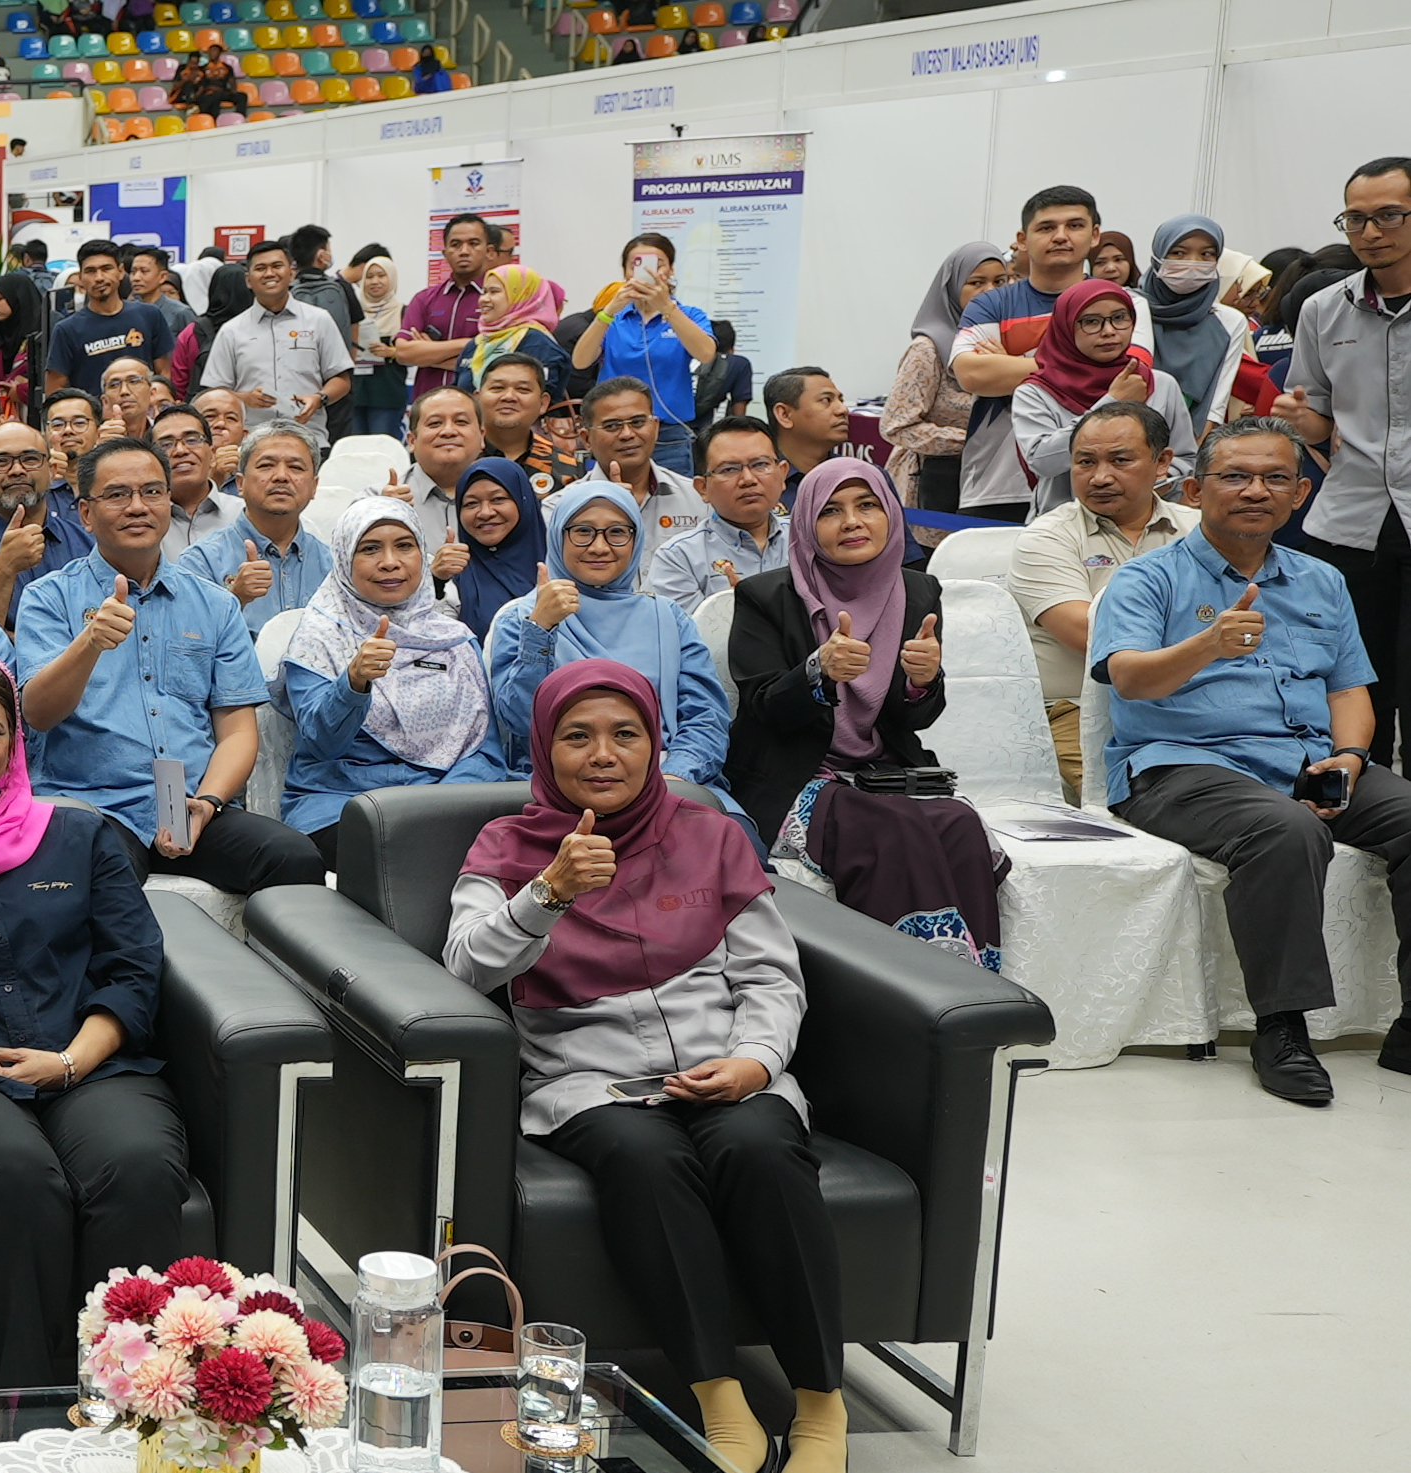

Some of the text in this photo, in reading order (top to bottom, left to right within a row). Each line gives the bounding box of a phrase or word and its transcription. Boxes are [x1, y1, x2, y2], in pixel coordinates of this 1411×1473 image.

[989, 38, 1017, 67] SABAH
[710, 152, 742, 167] UMS
[641, 177, 792, 196] PROGRAM PRASISWAZAH
[719, 202, 788, 214] ALIRAN SASTERA
[84, 334, 126, 353] KAWAT
[672, 515, 698, 526] UTM
